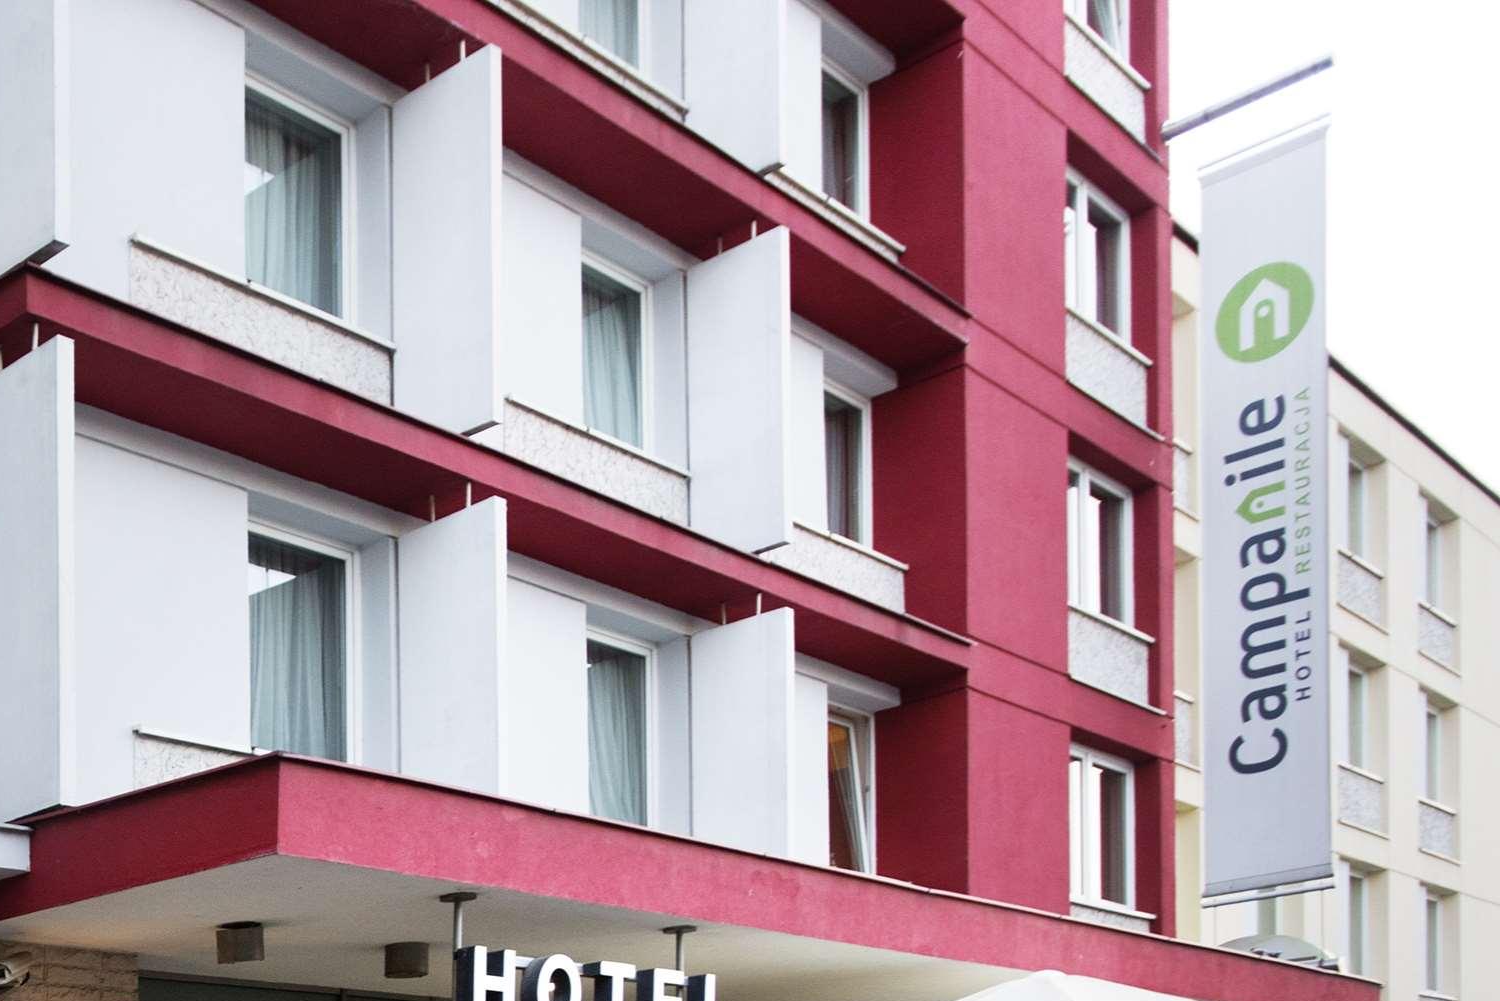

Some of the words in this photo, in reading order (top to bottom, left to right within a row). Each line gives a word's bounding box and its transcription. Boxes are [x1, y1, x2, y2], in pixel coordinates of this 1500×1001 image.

[1294, 387, 1312, 575] RESTAURACJA
[1224, 394, 1311, 775] Campanile
[1295, 611, 1312, 701] HOTEL
